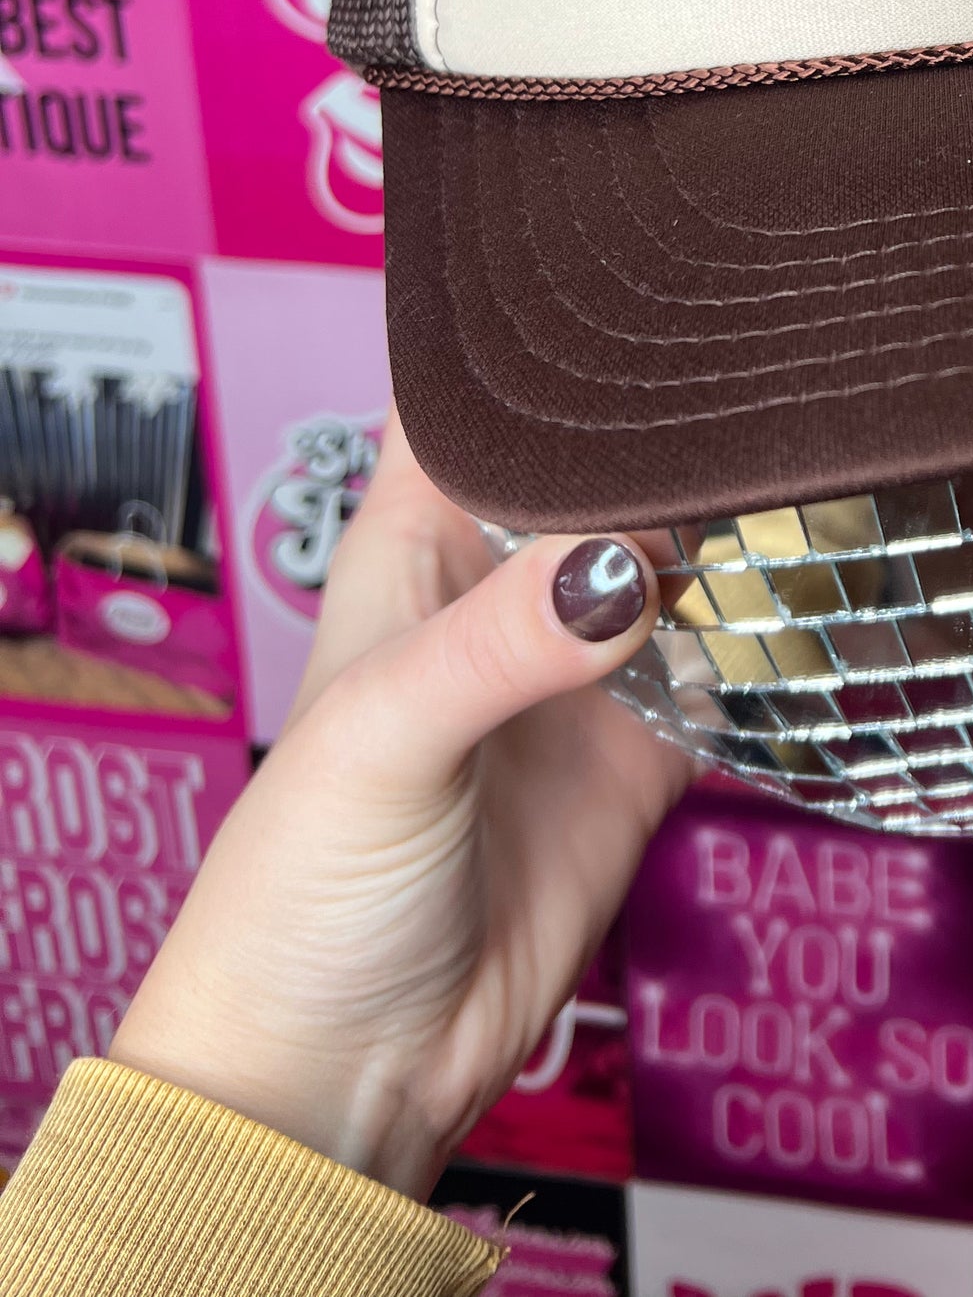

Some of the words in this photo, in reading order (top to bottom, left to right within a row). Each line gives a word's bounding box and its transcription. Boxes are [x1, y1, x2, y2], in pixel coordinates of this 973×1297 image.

[696, 827, 932, 930] BABE
[733, 912, 894, 1008] YOU
[640, 979, 852, 1087] LOOK
[711, 1084, 926, 1184] COOL
